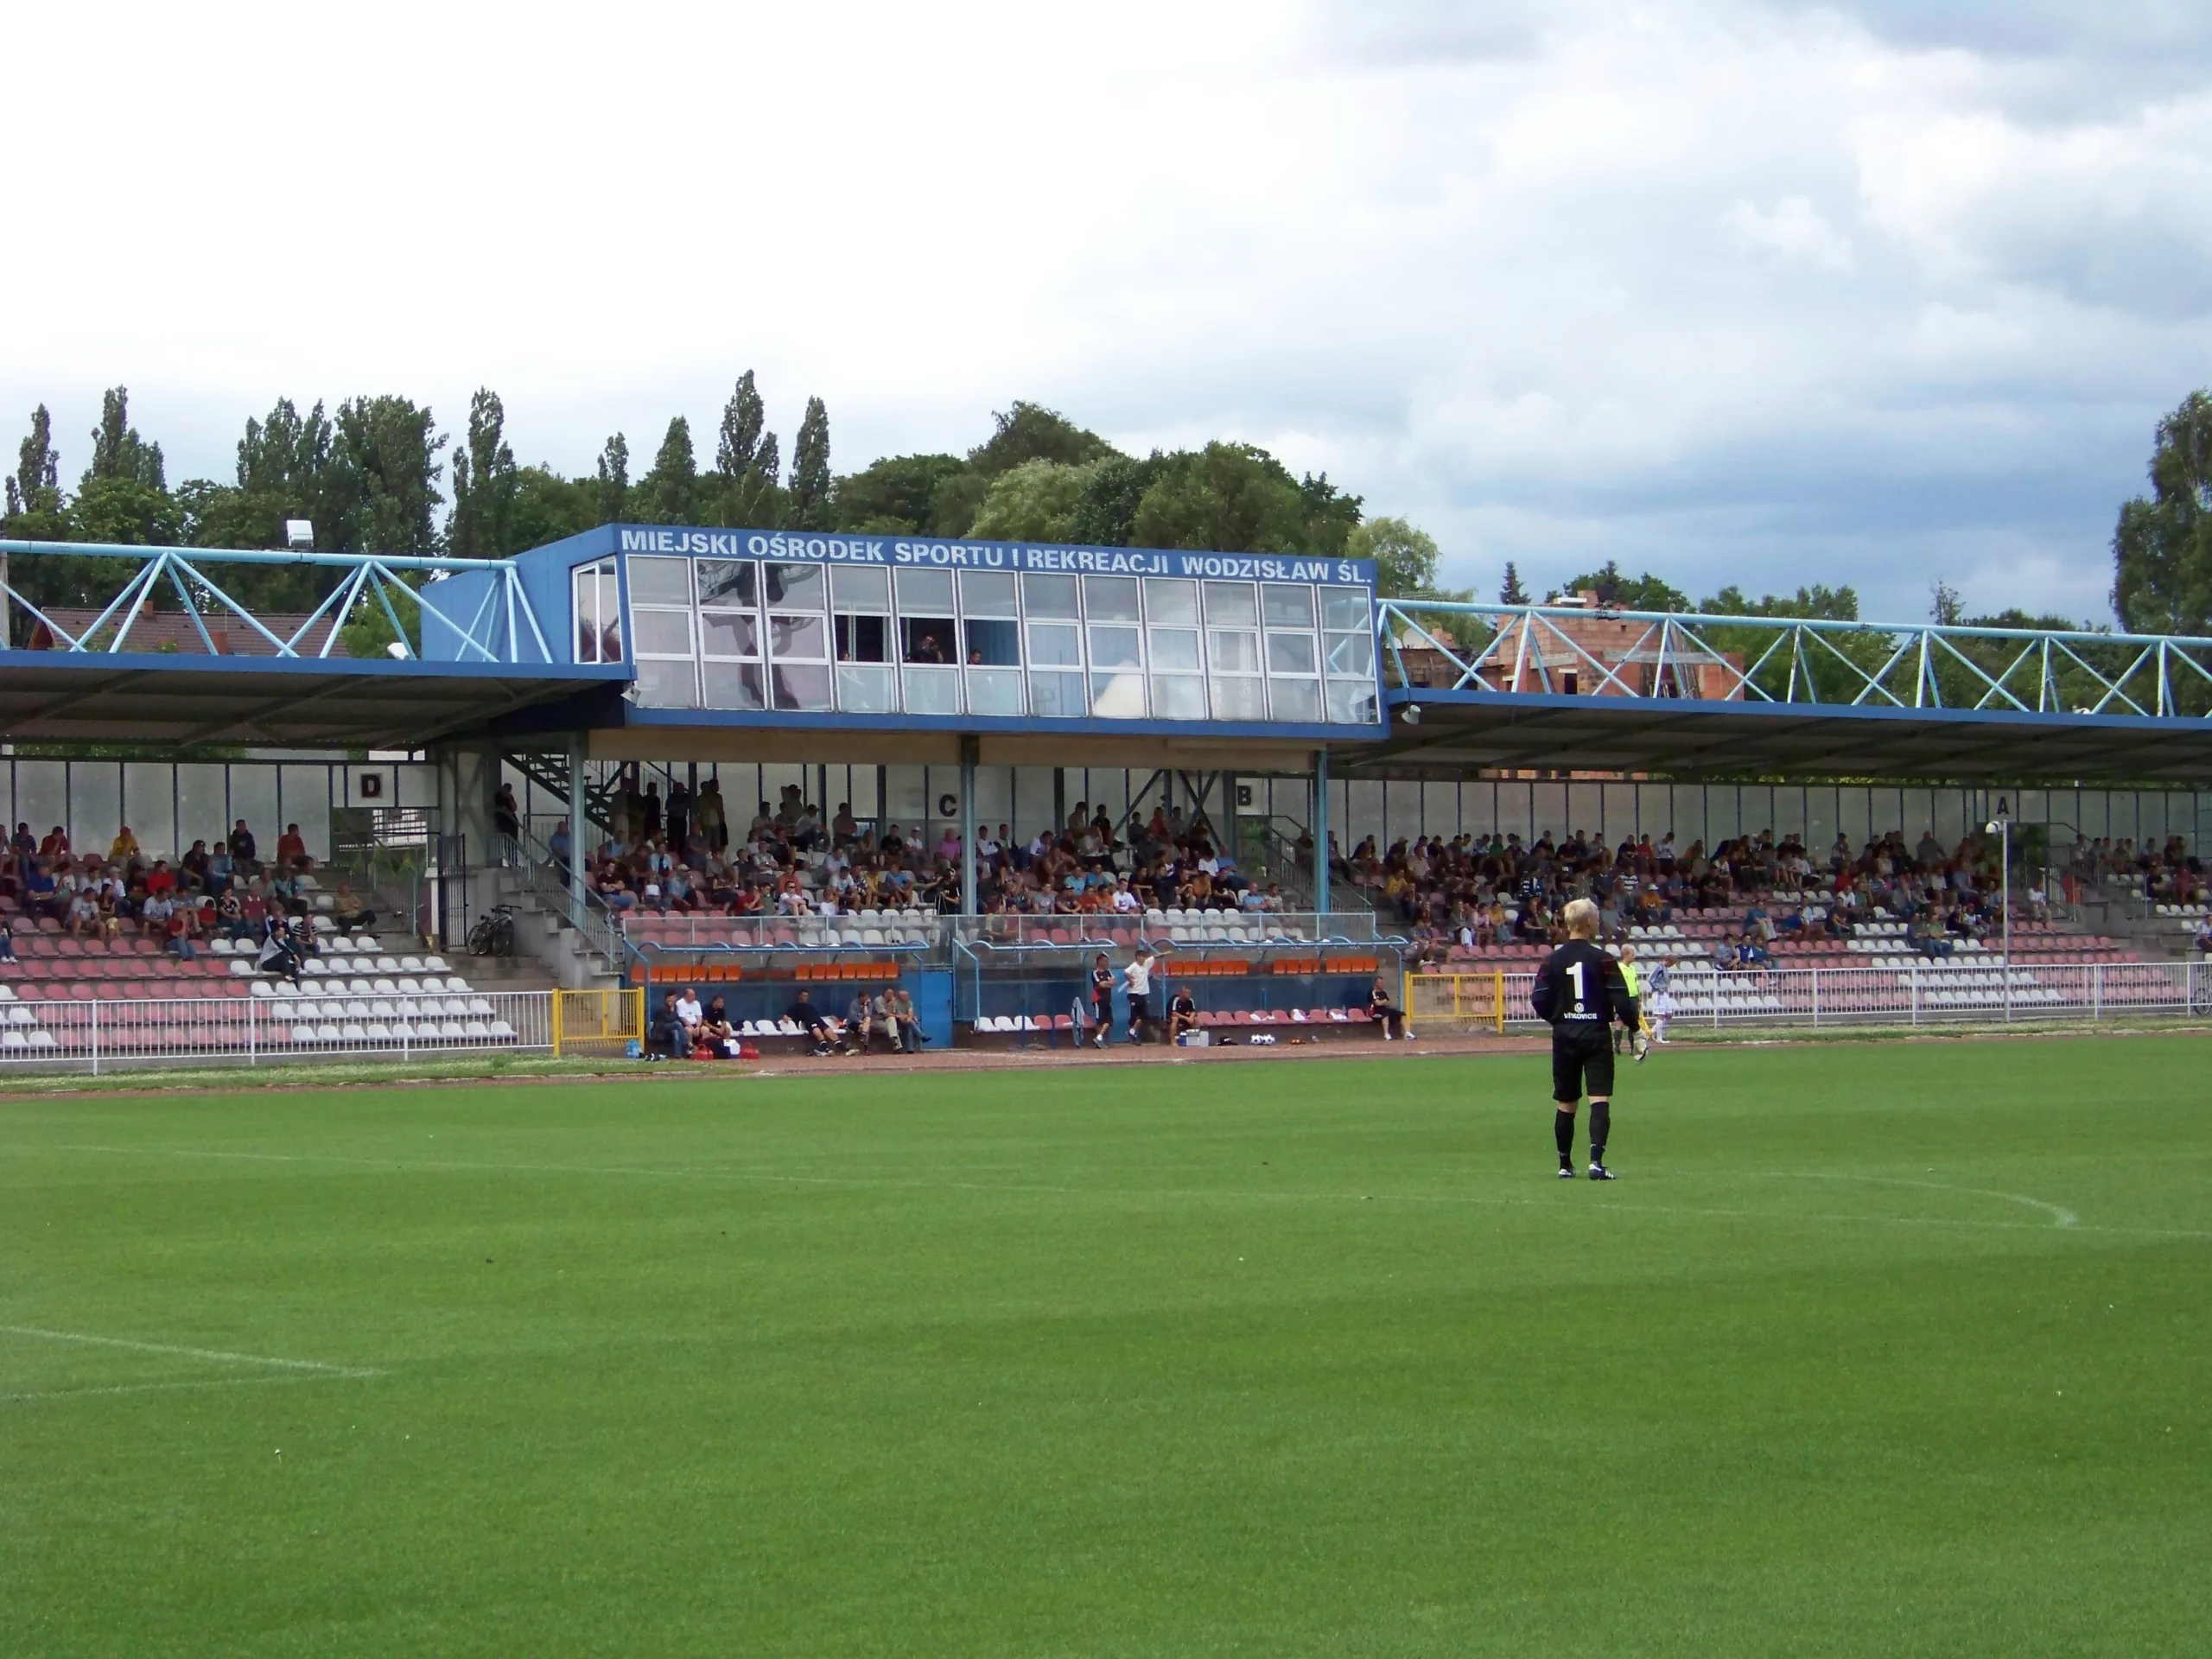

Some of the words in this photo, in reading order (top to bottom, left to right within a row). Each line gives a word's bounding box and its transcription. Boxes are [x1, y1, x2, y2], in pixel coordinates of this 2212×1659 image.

[621, 530, 737, 555] MIEJSKI
[747, 532, 885, 562] OŚRODEK
[894, 542, 1003, 566] SPORTU
[1012, 548, 1019, 567] I
[1027, 549, 1169, 575] REKREACJI
[1181, 556, 1329, 581] WODZISŁAW
[1338, 559, 1372, 583] ŚL.
[361, 774, 381, 798] D
[1237, 785, 1252, 805] B
[939, 794, 957, 817] C
[1997, 796, 2010, 815] A
[1566, 962, 1584, 1000] 1
